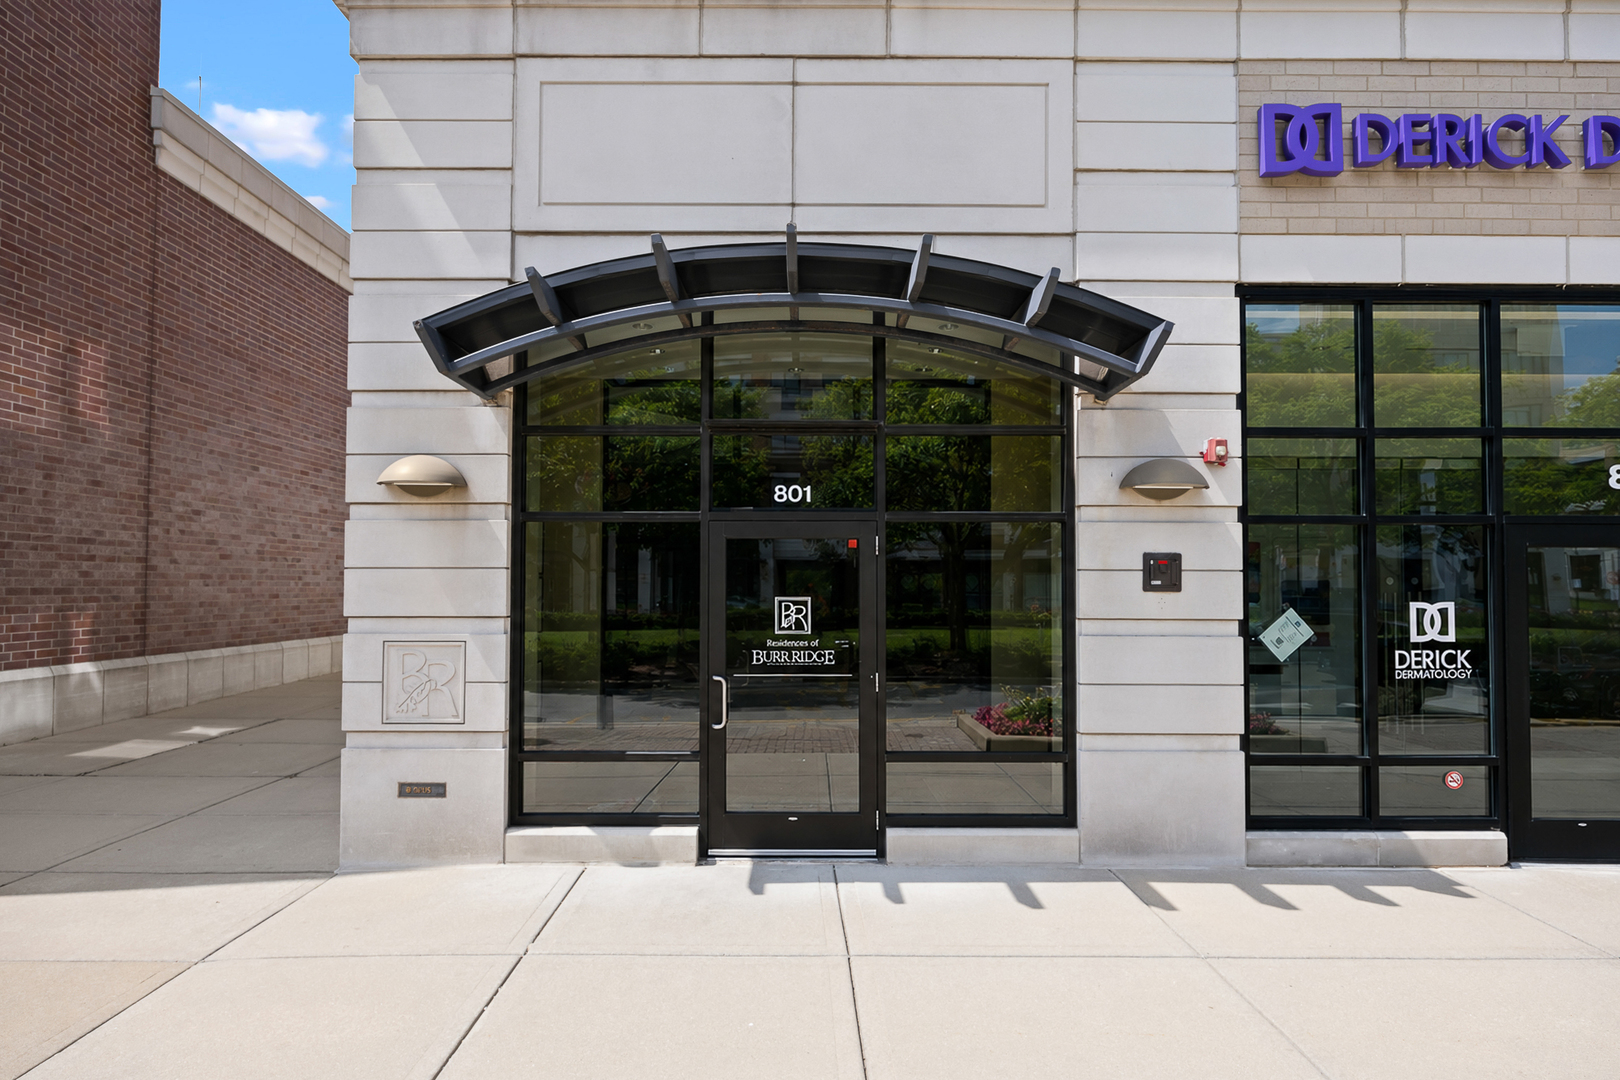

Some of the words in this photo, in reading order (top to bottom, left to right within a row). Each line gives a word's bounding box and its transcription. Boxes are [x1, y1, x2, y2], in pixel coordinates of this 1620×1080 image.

[1351, 113, 1572, 169] DERICK
[774, 485, 812, 502] 801
[766, 639, 809, 647] Residences
[810, 639, 819, 647] of
[751, 650, 790, 665] BURR
[791, 650, 835, 665] RIDGE
[1395, 649, 1472, 669] DERICK
[1395, 669, 1473, 680] DERMATOLOGY
